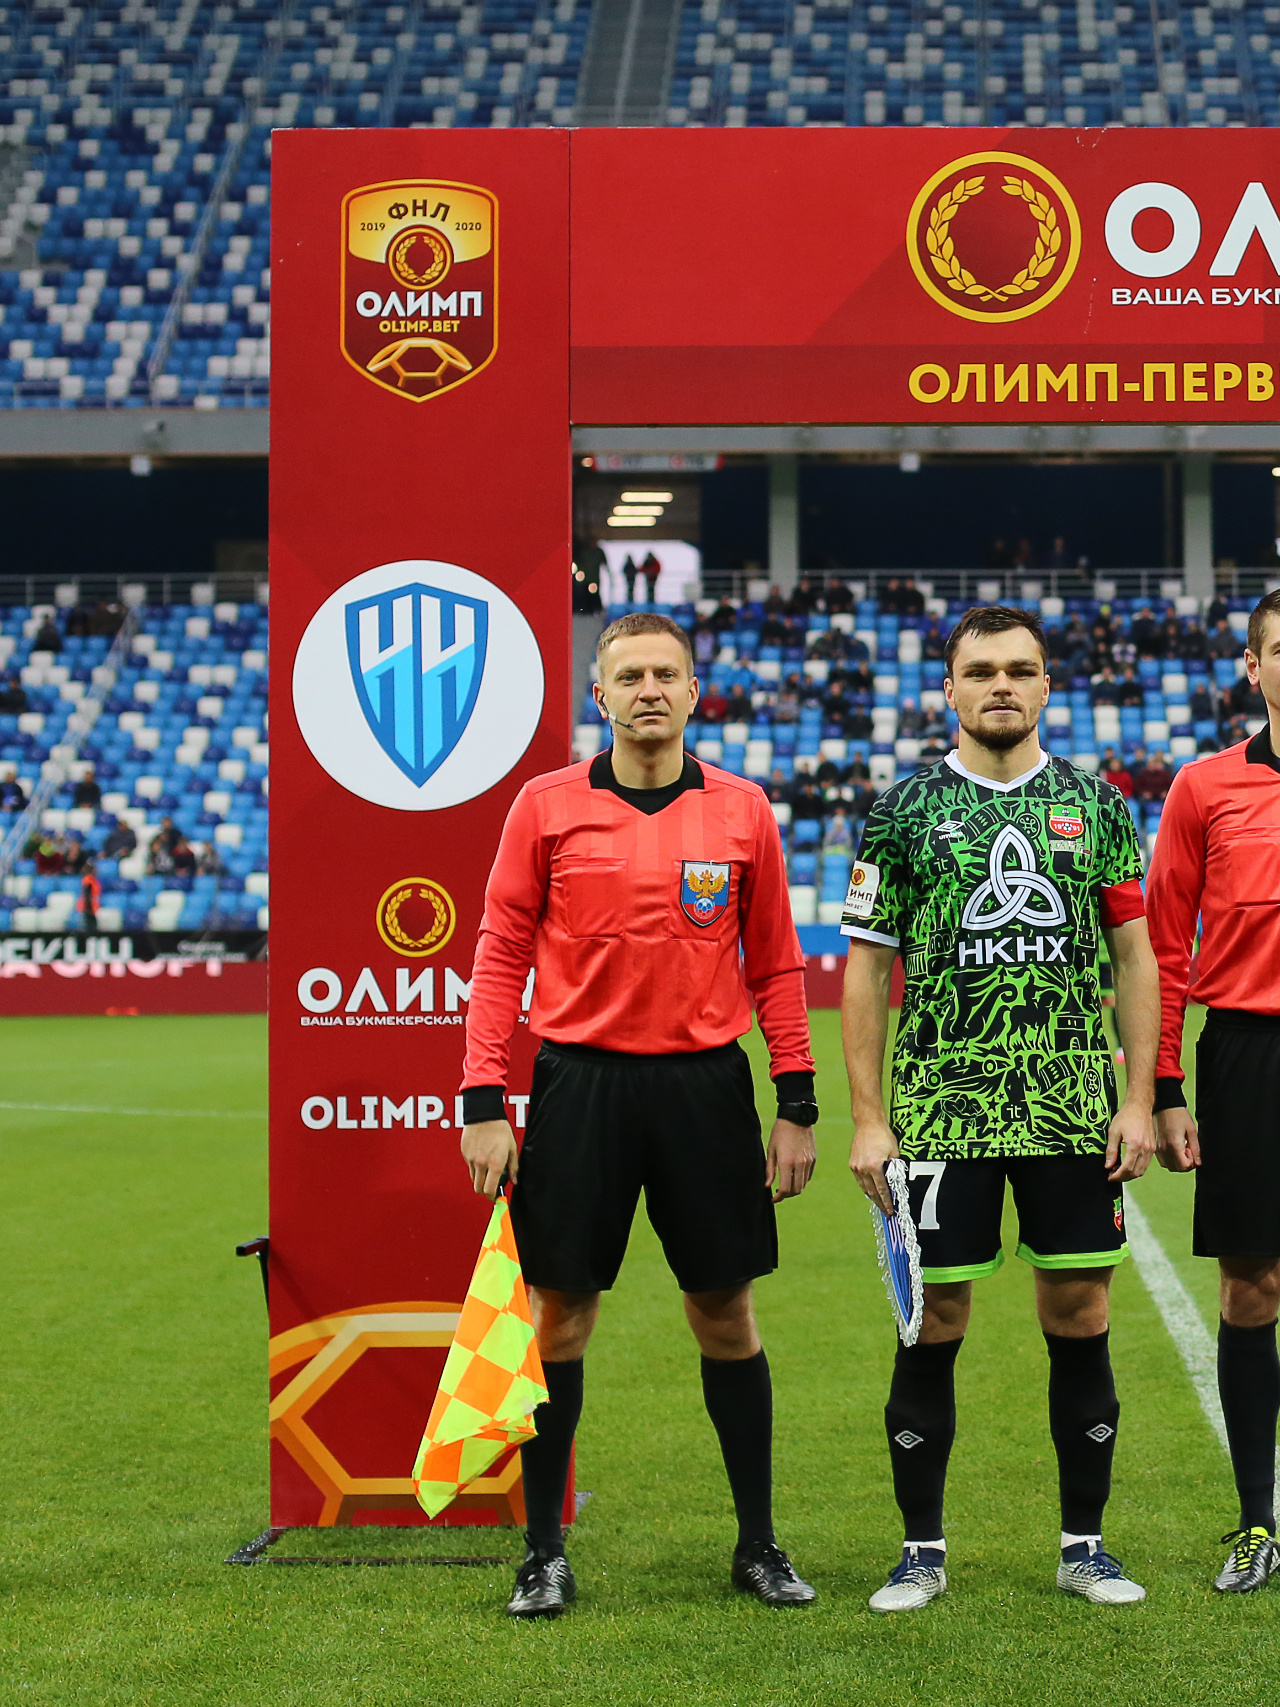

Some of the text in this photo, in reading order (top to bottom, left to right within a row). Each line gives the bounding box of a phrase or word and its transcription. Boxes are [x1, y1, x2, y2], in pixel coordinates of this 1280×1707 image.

[387, 199, 451, 222] ФНЛ
[360, 222, 482, 231] 2019 2020
[355, 290, 483, 318] ОЛИМП
[1111, 287, 1204, 305] ВАША
[378, 320, 461, 333] OLIMP.BET
[958, 935, 1068, 967] НКНХ
[297, 967, 536, 1014] ОЛИМ
[300, 1015, 344, 1027] ВАША
[346, 1015, 463, 1027] БУКМЕКЕРСКАЯ
[300, 1095, 531, 1130] OLIMP.T
[908, 1161, 947, 1230] 7
